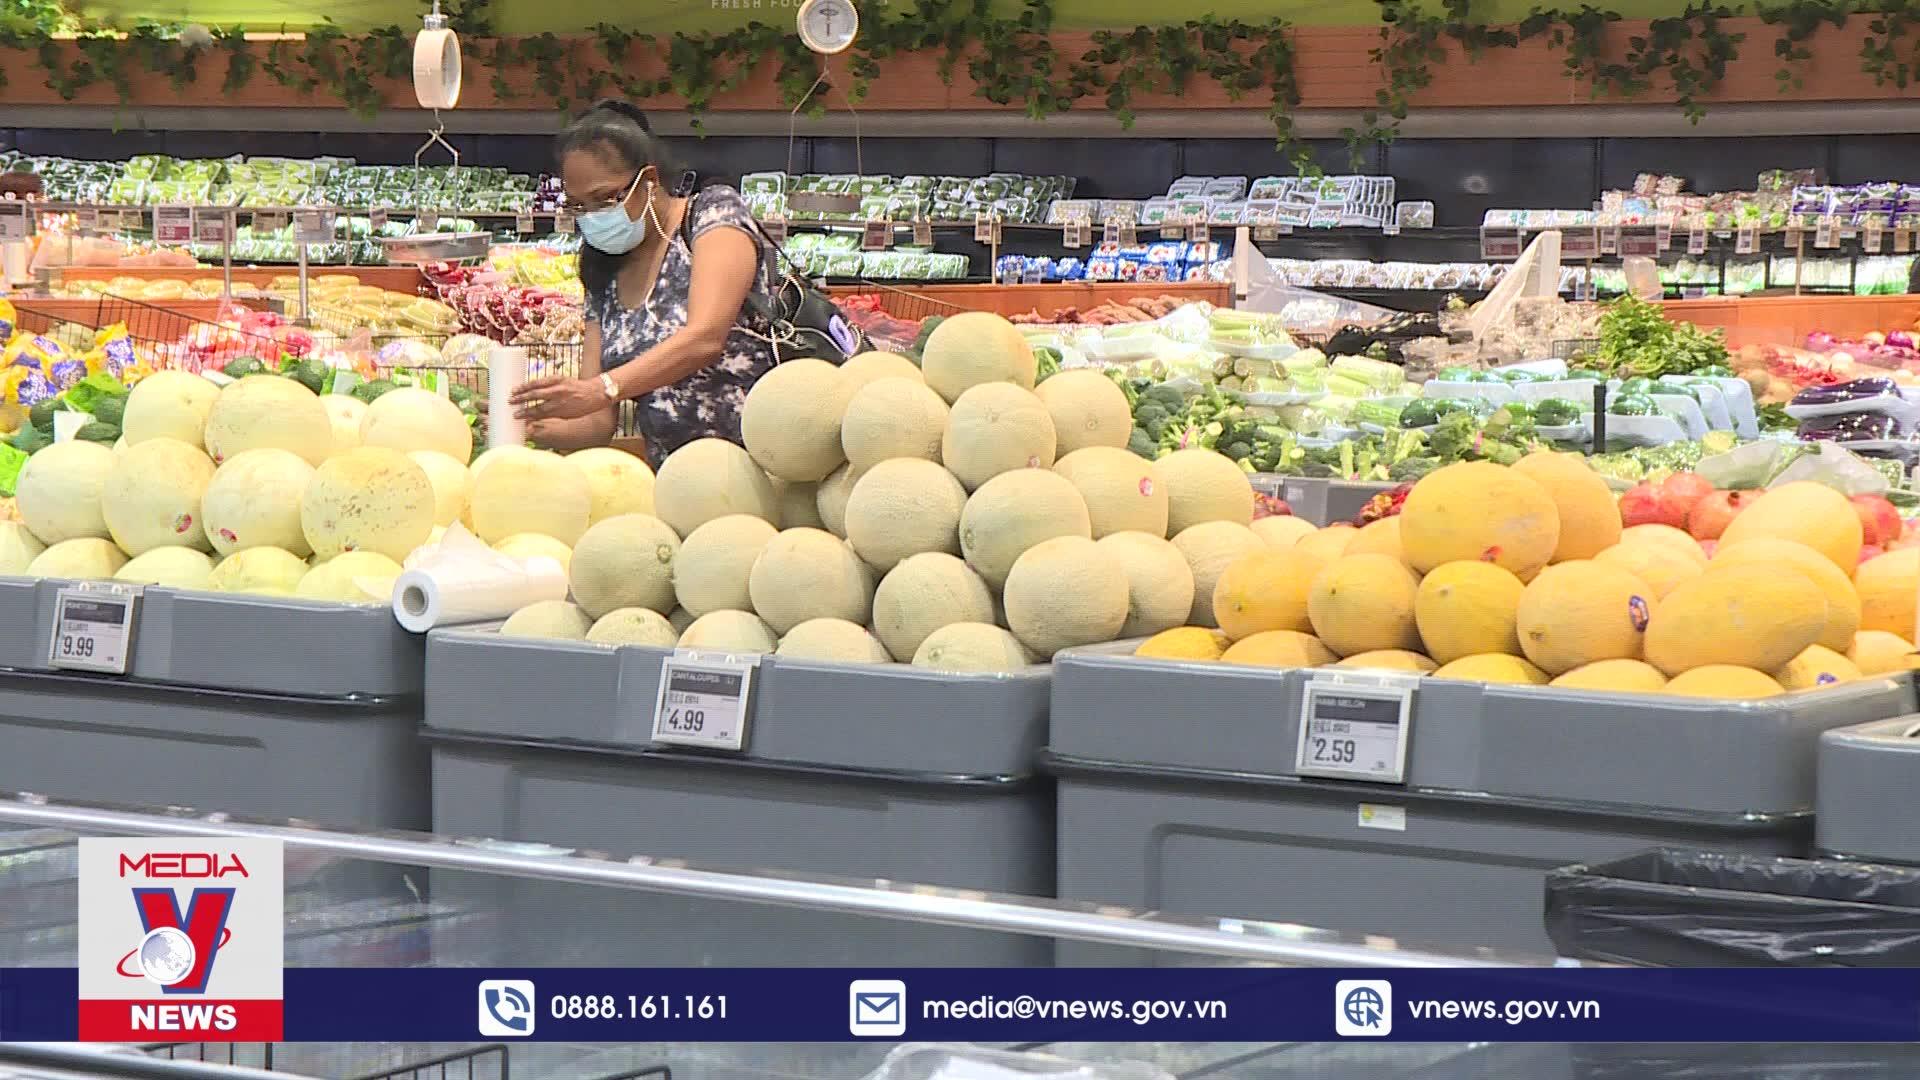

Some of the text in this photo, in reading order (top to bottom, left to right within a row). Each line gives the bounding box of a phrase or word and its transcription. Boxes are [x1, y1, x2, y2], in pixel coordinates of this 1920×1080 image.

[63, 635, 94, 657] 9.99
[668, 709, 705, 732] 4.99
[1314, 738, 1356, 763] 2.59
